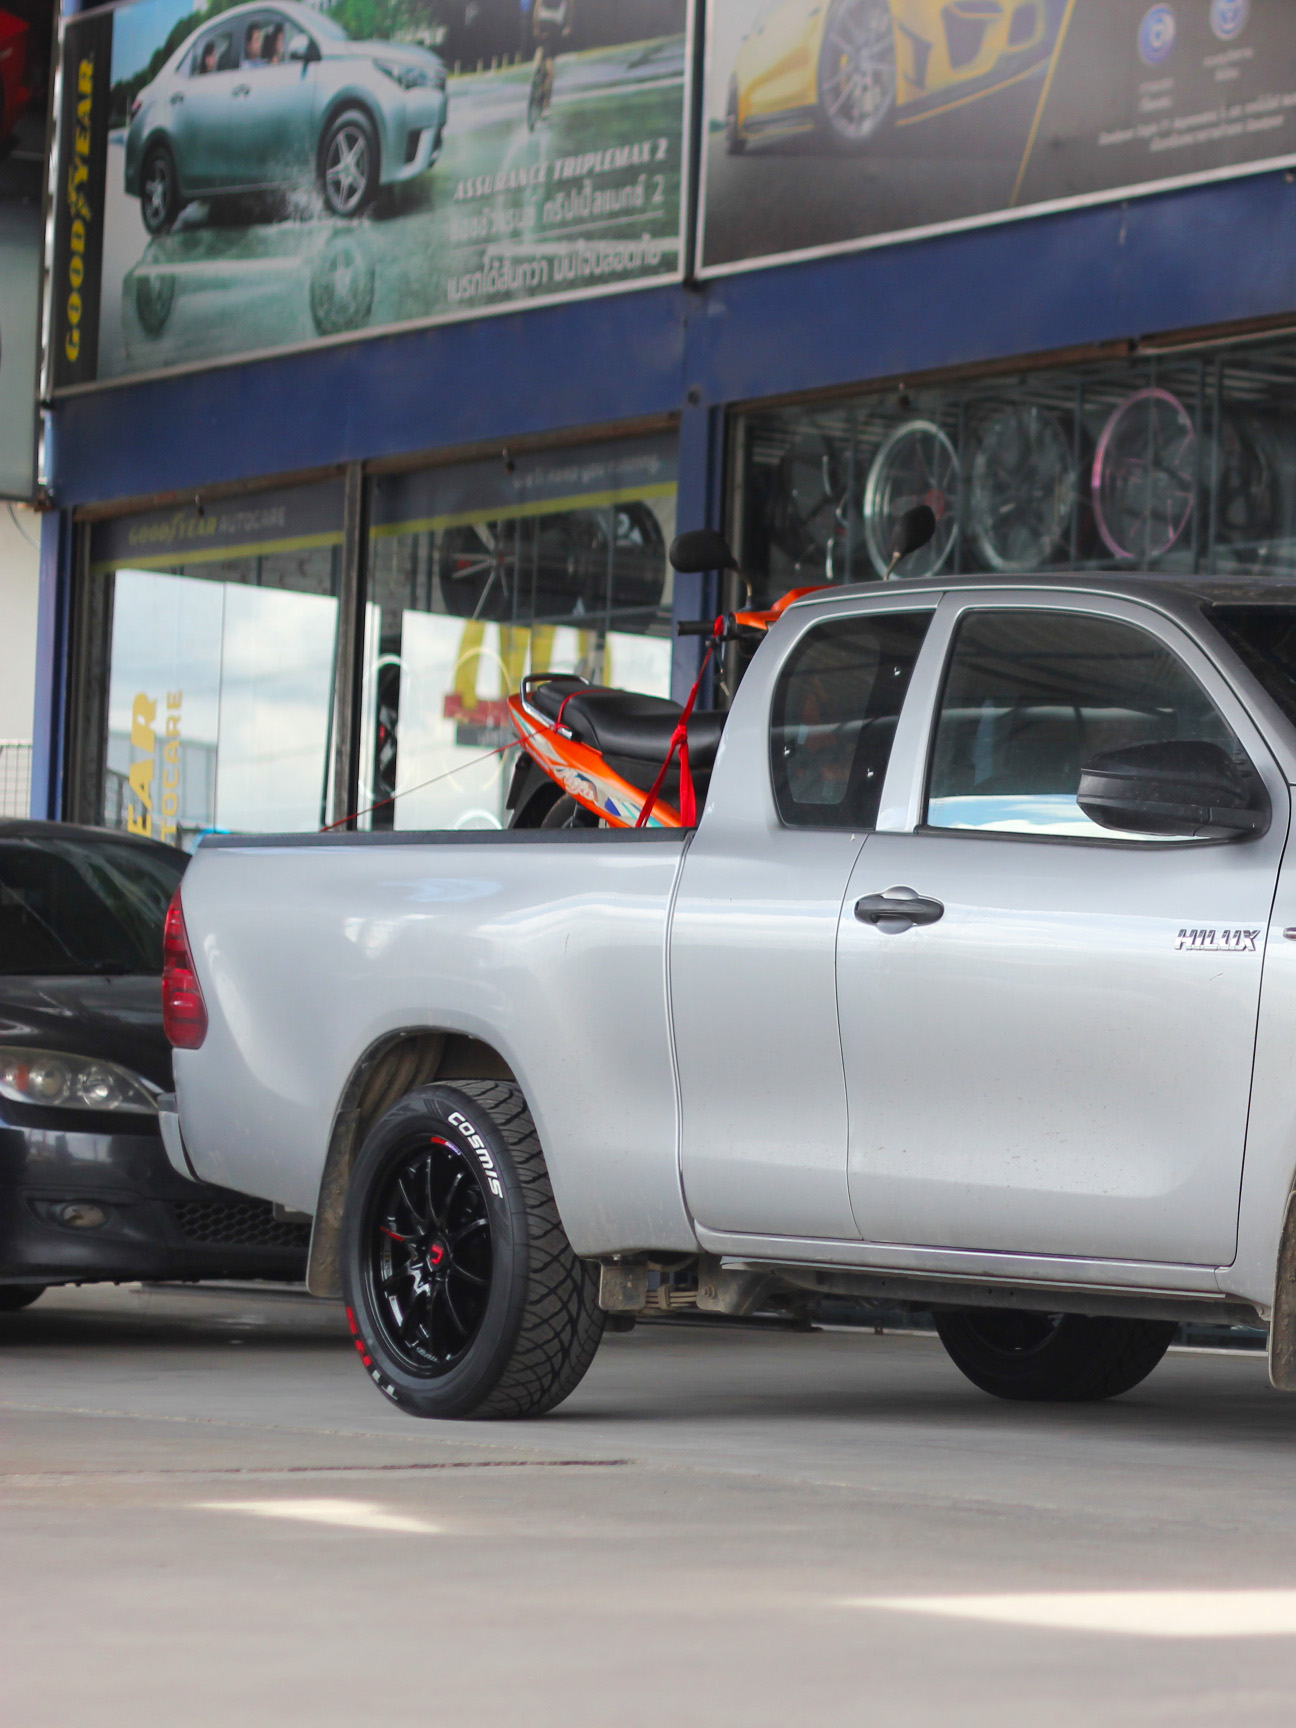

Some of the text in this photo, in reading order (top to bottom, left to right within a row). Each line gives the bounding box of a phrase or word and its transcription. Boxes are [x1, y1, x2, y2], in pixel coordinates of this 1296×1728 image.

[453, 137, 668, 201] ASSURANCE TRIPLEMAX 2
[652, 174, 665, 203] 2
[65, 54, 96, 363] GOODYEAR
[1174, 928, 1261, 952] HILUX
[448, 1111, 504, 1200] COSMIS
